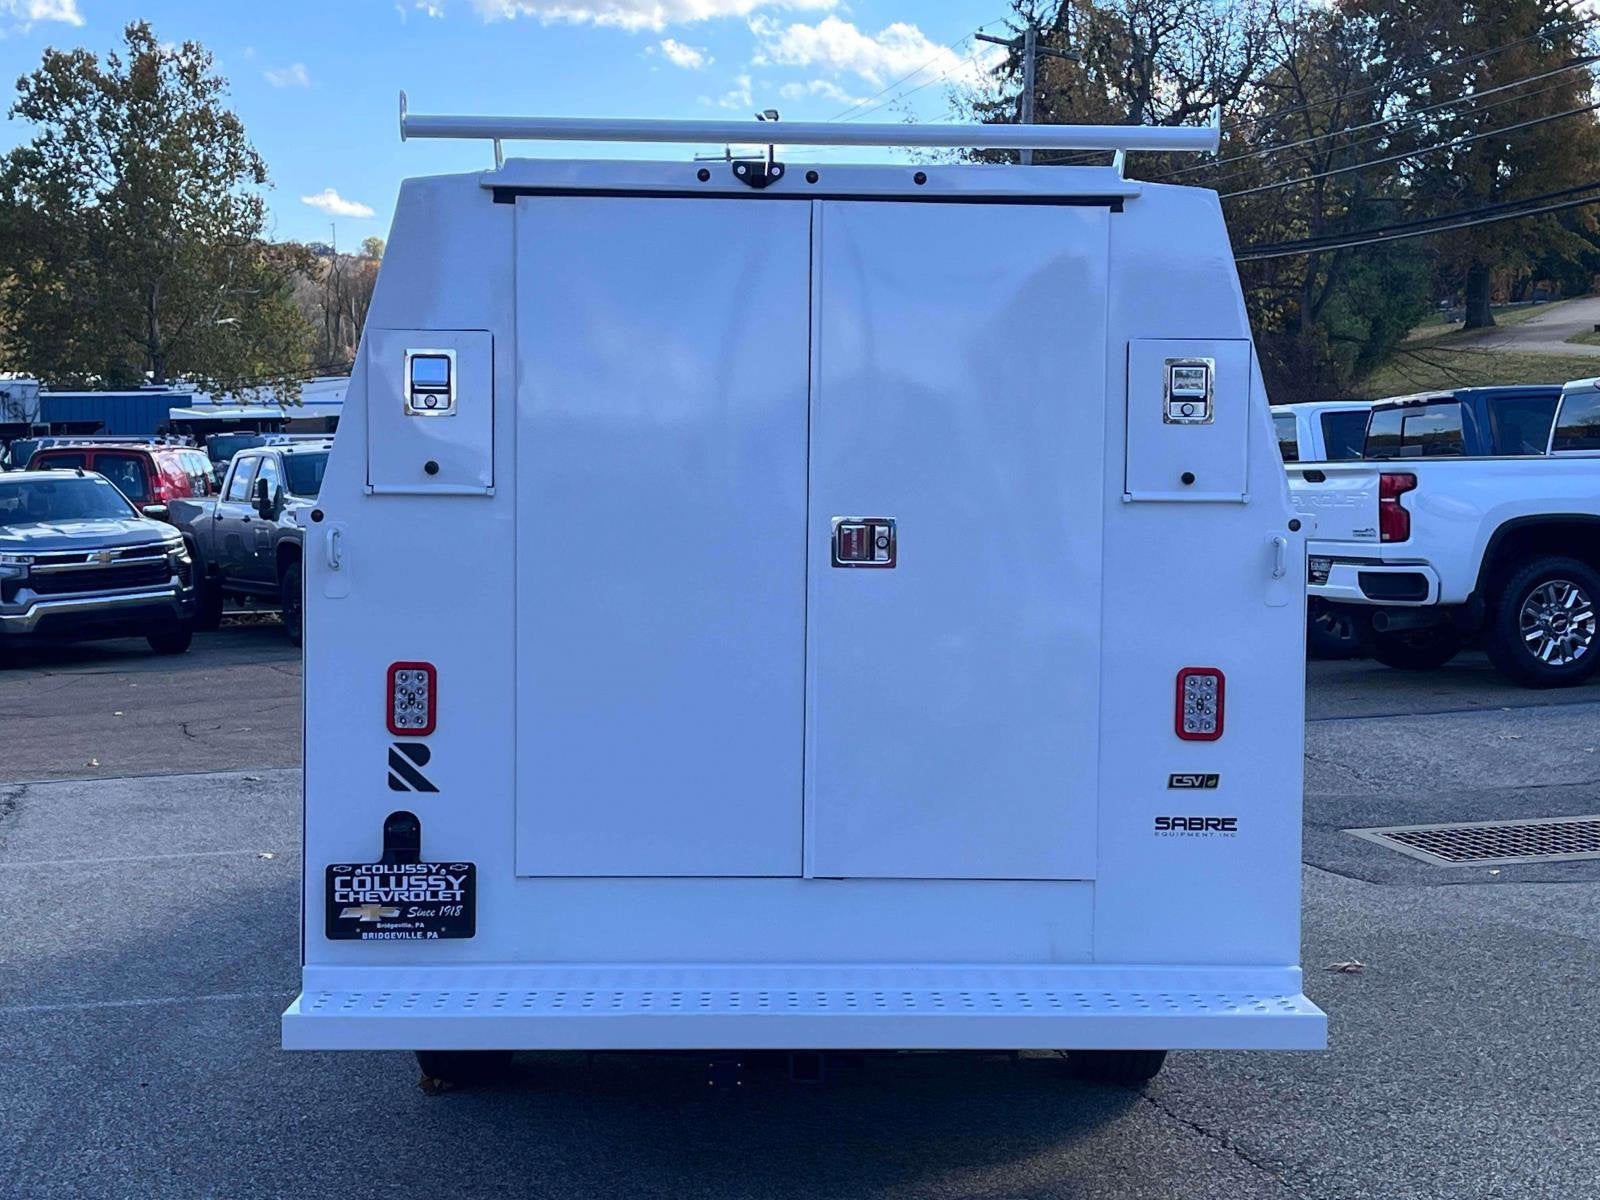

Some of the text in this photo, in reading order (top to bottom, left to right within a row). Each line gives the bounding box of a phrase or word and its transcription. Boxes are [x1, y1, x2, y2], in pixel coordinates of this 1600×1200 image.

[1173, 776, 1203, 786] CSV
[1154, 816, 1238, 831] SABRE
[362, 864, 440, 874] COLUSSY
[335, 875, 467, 891] COLUSSY
[335, 890, 465, 902] CHEVROLET
[406, 905, 463, 918] Since 1918
[426, 931, 439, 939] PA
